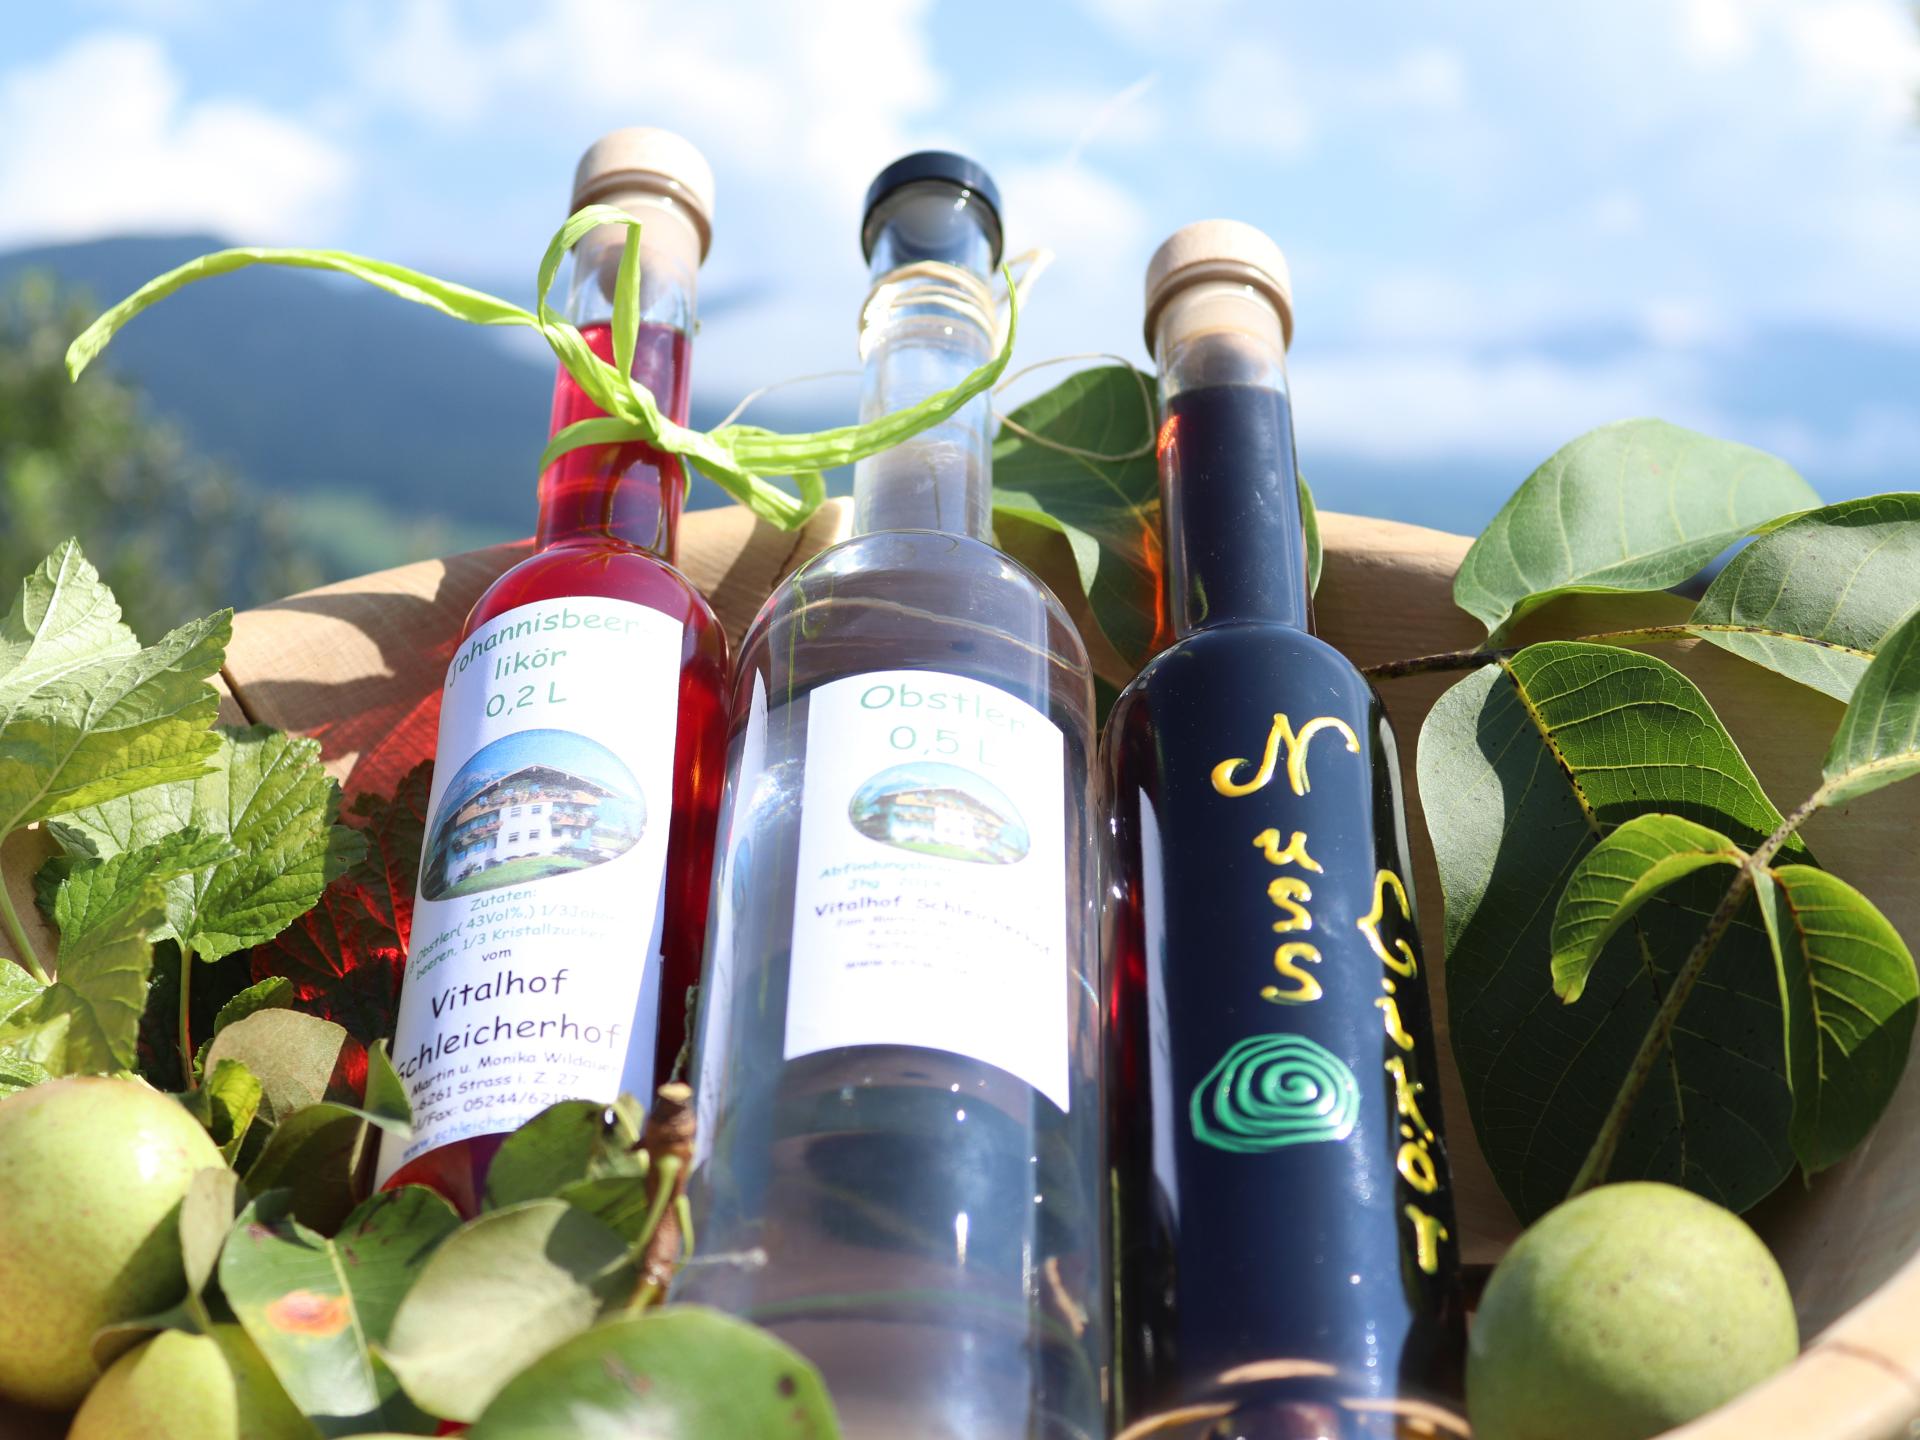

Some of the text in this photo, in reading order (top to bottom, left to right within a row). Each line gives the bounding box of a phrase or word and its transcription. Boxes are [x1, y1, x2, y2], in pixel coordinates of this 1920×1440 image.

[494, 647, 568, 681] likör
[485, 681, 567, 718] 0,2 L
[861, 683, 1026, 736] Obstler
[889, 726, 999, 768] 0,5 L
[1211, 713, 1360, 1004] Nuss
[816, 896, 902, 918] Vitalhof
[463, 932, 487, 951] 1/3
[481, 949, 512, 962] vom
[432, 968, 568, 1019] Vitalhof
[478, 1052, 538, 1070] Monika
[456, 1075, 512, 1096] Strass
[557, 1074, 579, 1089] 27
